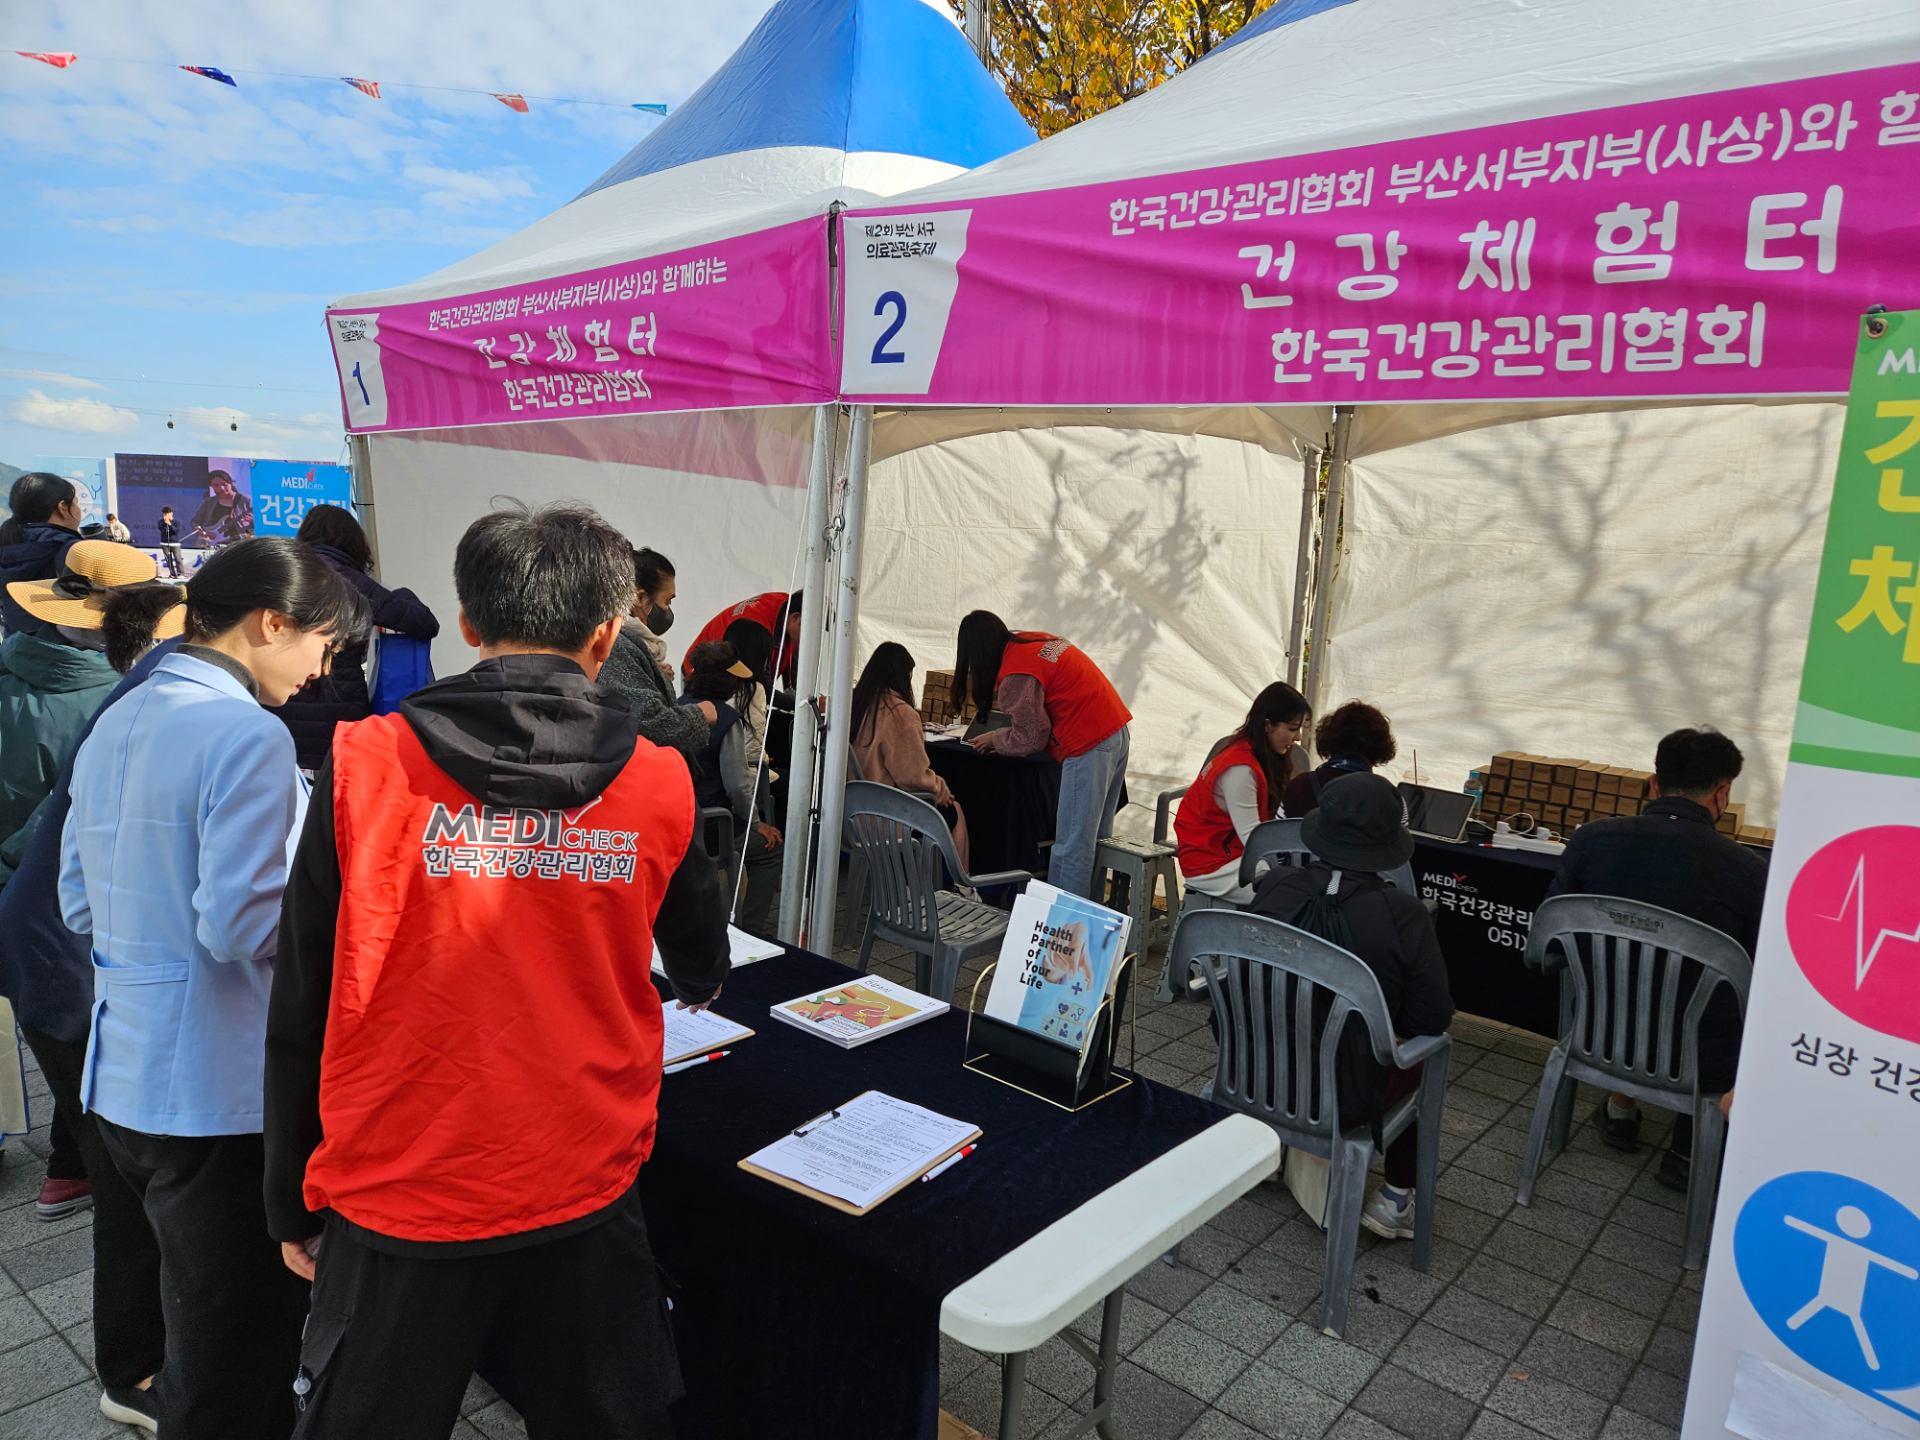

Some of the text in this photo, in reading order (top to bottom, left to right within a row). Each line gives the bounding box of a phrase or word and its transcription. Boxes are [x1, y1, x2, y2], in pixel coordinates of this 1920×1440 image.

[1110, 166, 1375, 235] 한국건강관리협회
[1385, 100, 1858, 203] 부산서부지부(사상)와
[865, 222, 935, 238] 제2회 부산 서구
[867, 241, 937, 259] 의료관광축제
[429, 256, 727, 331] 한국건강관리협회 부산서부지부(사상)와 함께하는
[871, 291, 907, 363] 2
[1271, 301, 1765, 383] 한국건강관리협회
[353, 361, 370, 405] 1
[503, 369, 651, 411] 한국건강관리협회
[423, 845, 637, 883] 한국건강관리협회
[1030, 934, 1075, 957] Partner
[1034, 920, 1072, 941] Health
[1025, 960, 1050, 978] Your
[1027, 948, 1041, 960] of
[1019, 973, 1043, 989] Life
[1791, 1032, 1859, 1076] 심장
